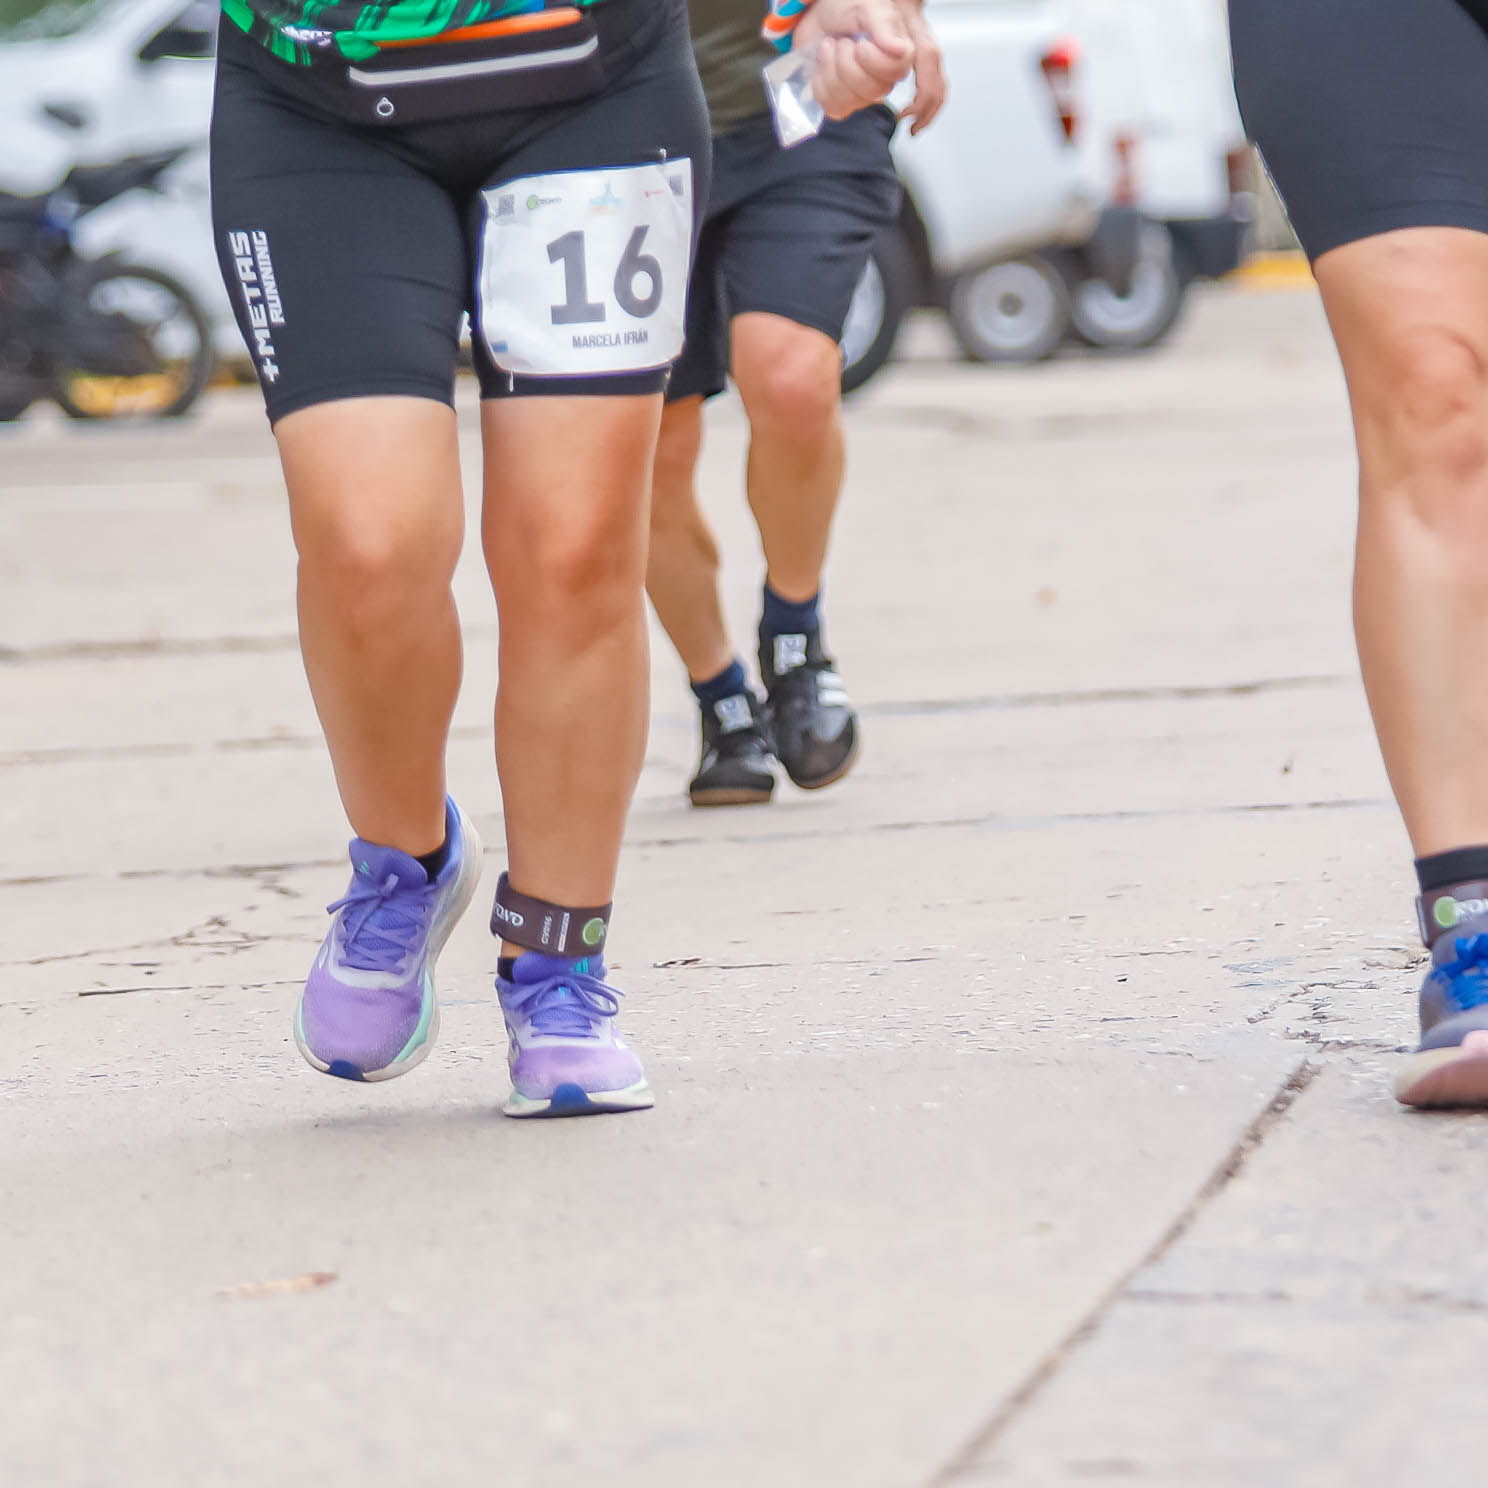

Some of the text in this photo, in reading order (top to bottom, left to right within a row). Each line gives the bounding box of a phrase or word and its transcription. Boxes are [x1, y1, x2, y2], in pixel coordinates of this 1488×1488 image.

[228, 230, 281, 384] +METAS
[250, 230, 286, 325] RUNNING
[545, 223, 665, 325] 16
[572, 334, 622, 349] MARCELA
